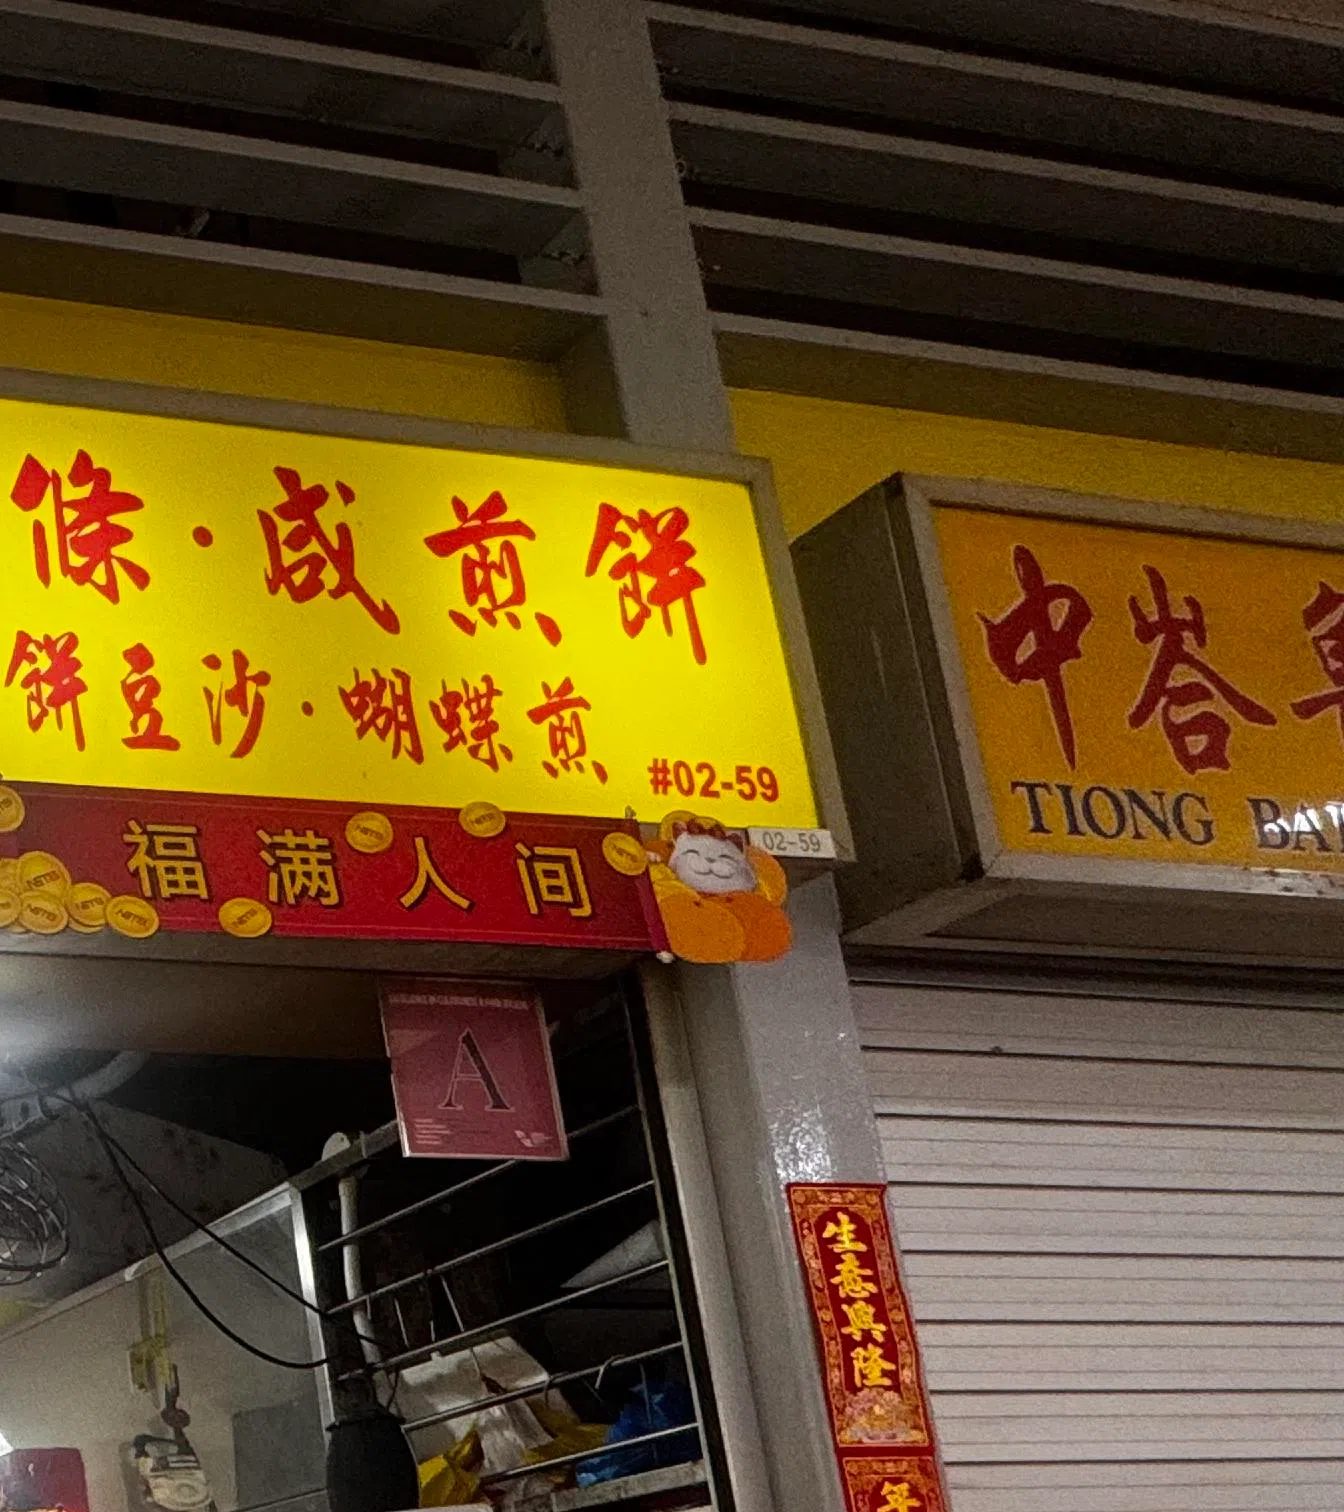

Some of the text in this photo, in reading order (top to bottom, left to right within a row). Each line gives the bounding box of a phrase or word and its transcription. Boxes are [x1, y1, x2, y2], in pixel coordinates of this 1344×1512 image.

[648, 758, 779, 803] #02-59
[1011, 780, 1214, 846] TIONG
[123, 819, 593, 918] 福满人间
[761, 831, 822, 853] 02-59
[438, 1027, 515, 1112] A
